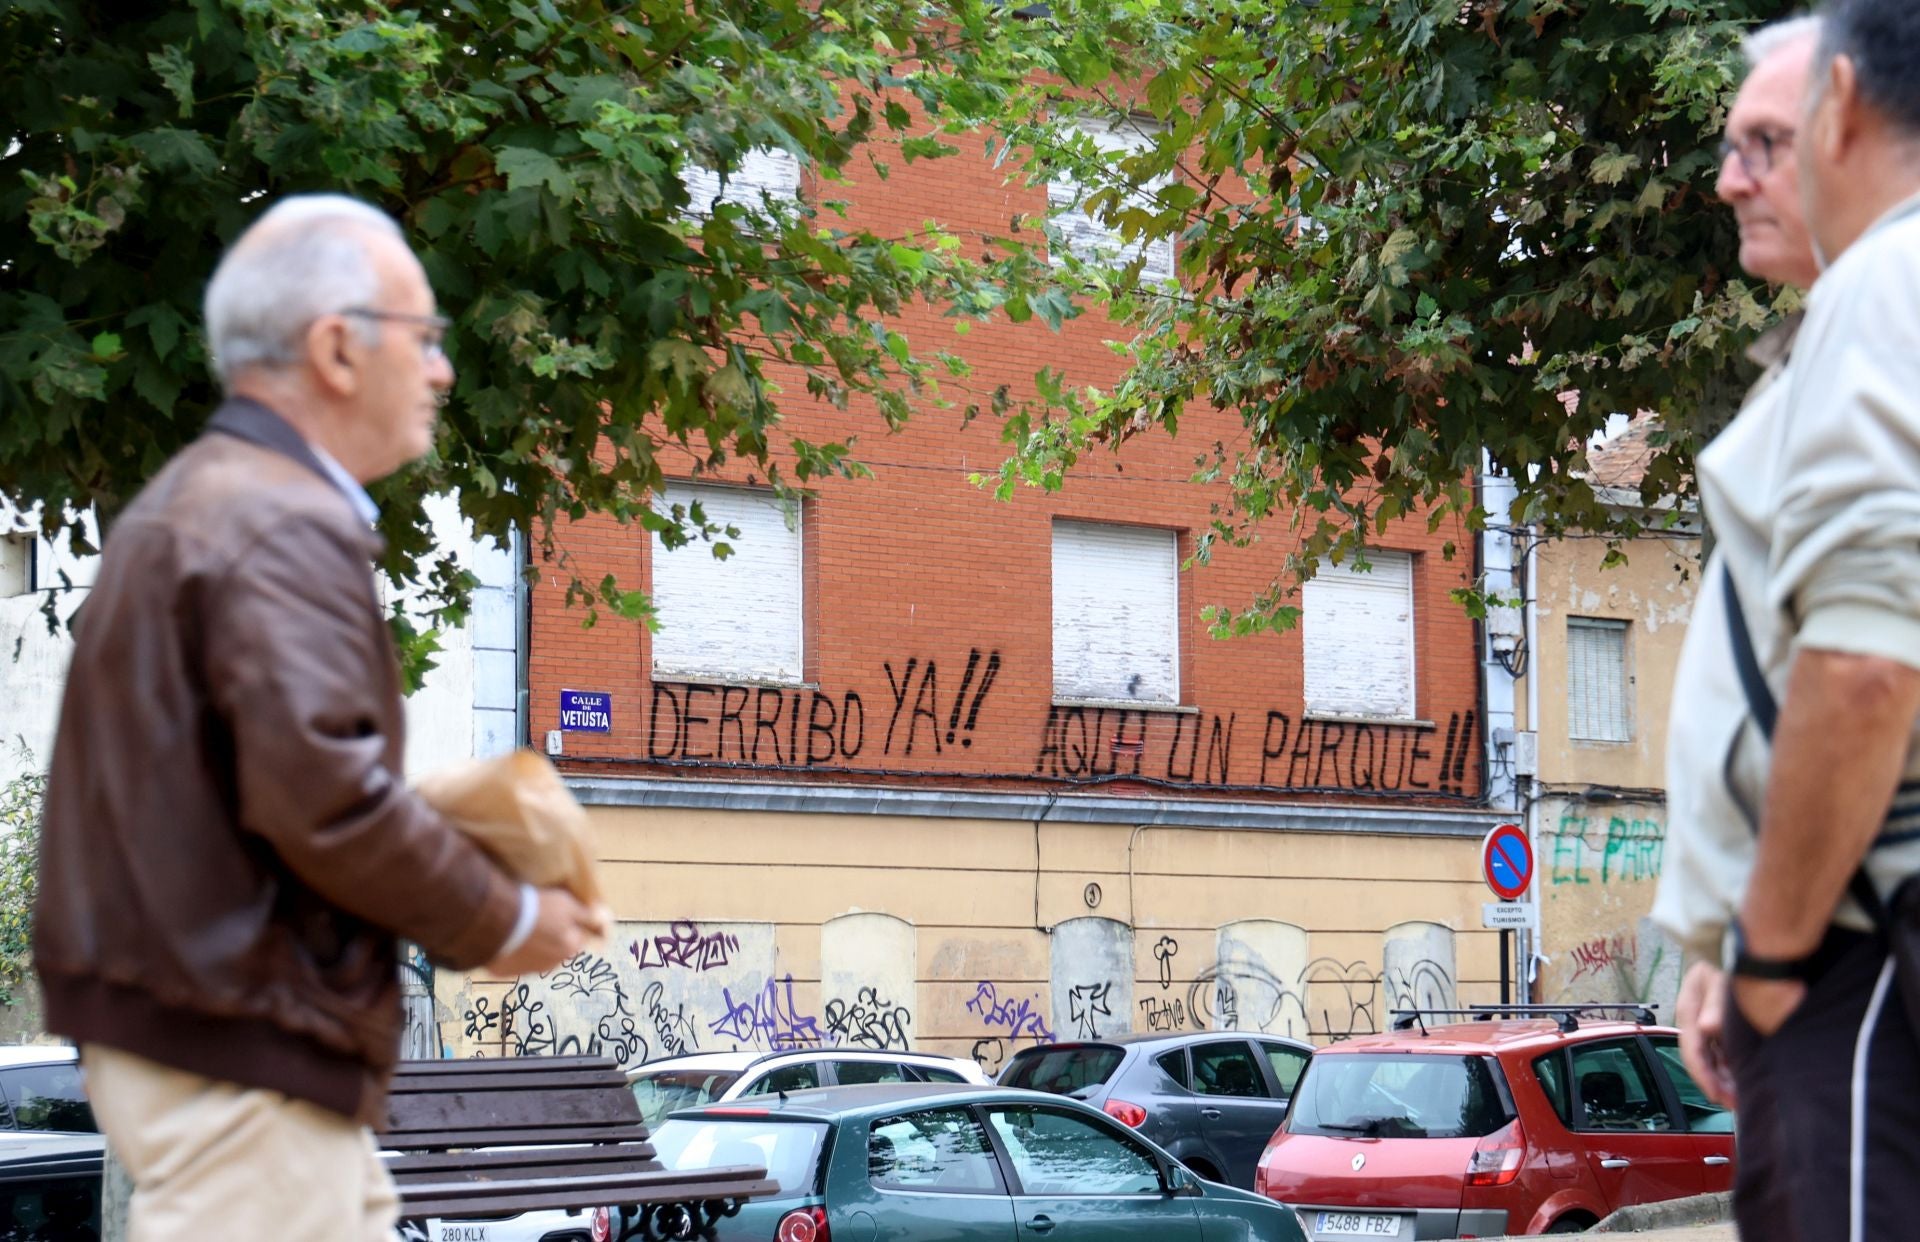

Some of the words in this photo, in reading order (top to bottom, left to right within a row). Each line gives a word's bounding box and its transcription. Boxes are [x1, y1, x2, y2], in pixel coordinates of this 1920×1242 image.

[571, 696, 602, 706] CALLE
[648, 683, 865, 766] DERRIBO
[883, 647, 1001, 756] YA!!
[562, 710, 609, 728] VETUSTA
[1167, 712, 1236, 784] UN
[1552, 816, 1590, 885] EL
[1602, 815, 1667, 883] PAR
[1496, 906, 1523, 914] EXCEPTO
[1492, 916, 1527, 924] TURISMOS
[1326, 1214, 1361, 1232] 5488
[1365, 1215, 1394, 1234] FBZ
[442, 1227, 462, 1242] 280
[464, 1226, 486, 1241] KLX
